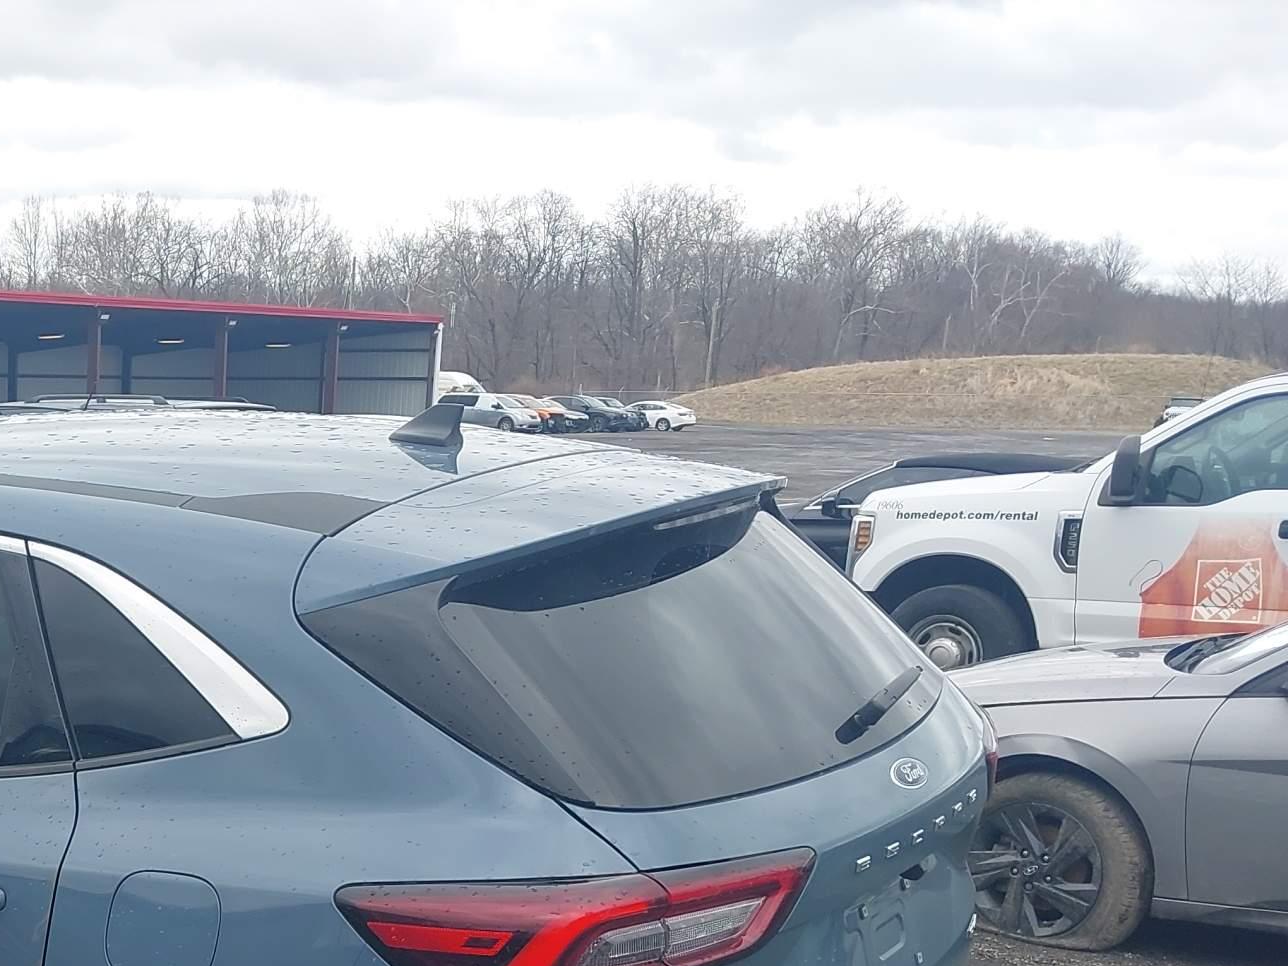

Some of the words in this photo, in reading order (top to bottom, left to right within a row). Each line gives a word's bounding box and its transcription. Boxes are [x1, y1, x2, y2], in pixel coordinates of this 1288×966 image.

[896, 510, 1039, 521] homedepot.com/rental
[1194, 561, 1260, 620] HOME
[1203, 567, 1233, 591] THE
[1217, 583, 1261, 621] DEPOT
[900, 762, 925, 782] Ford
